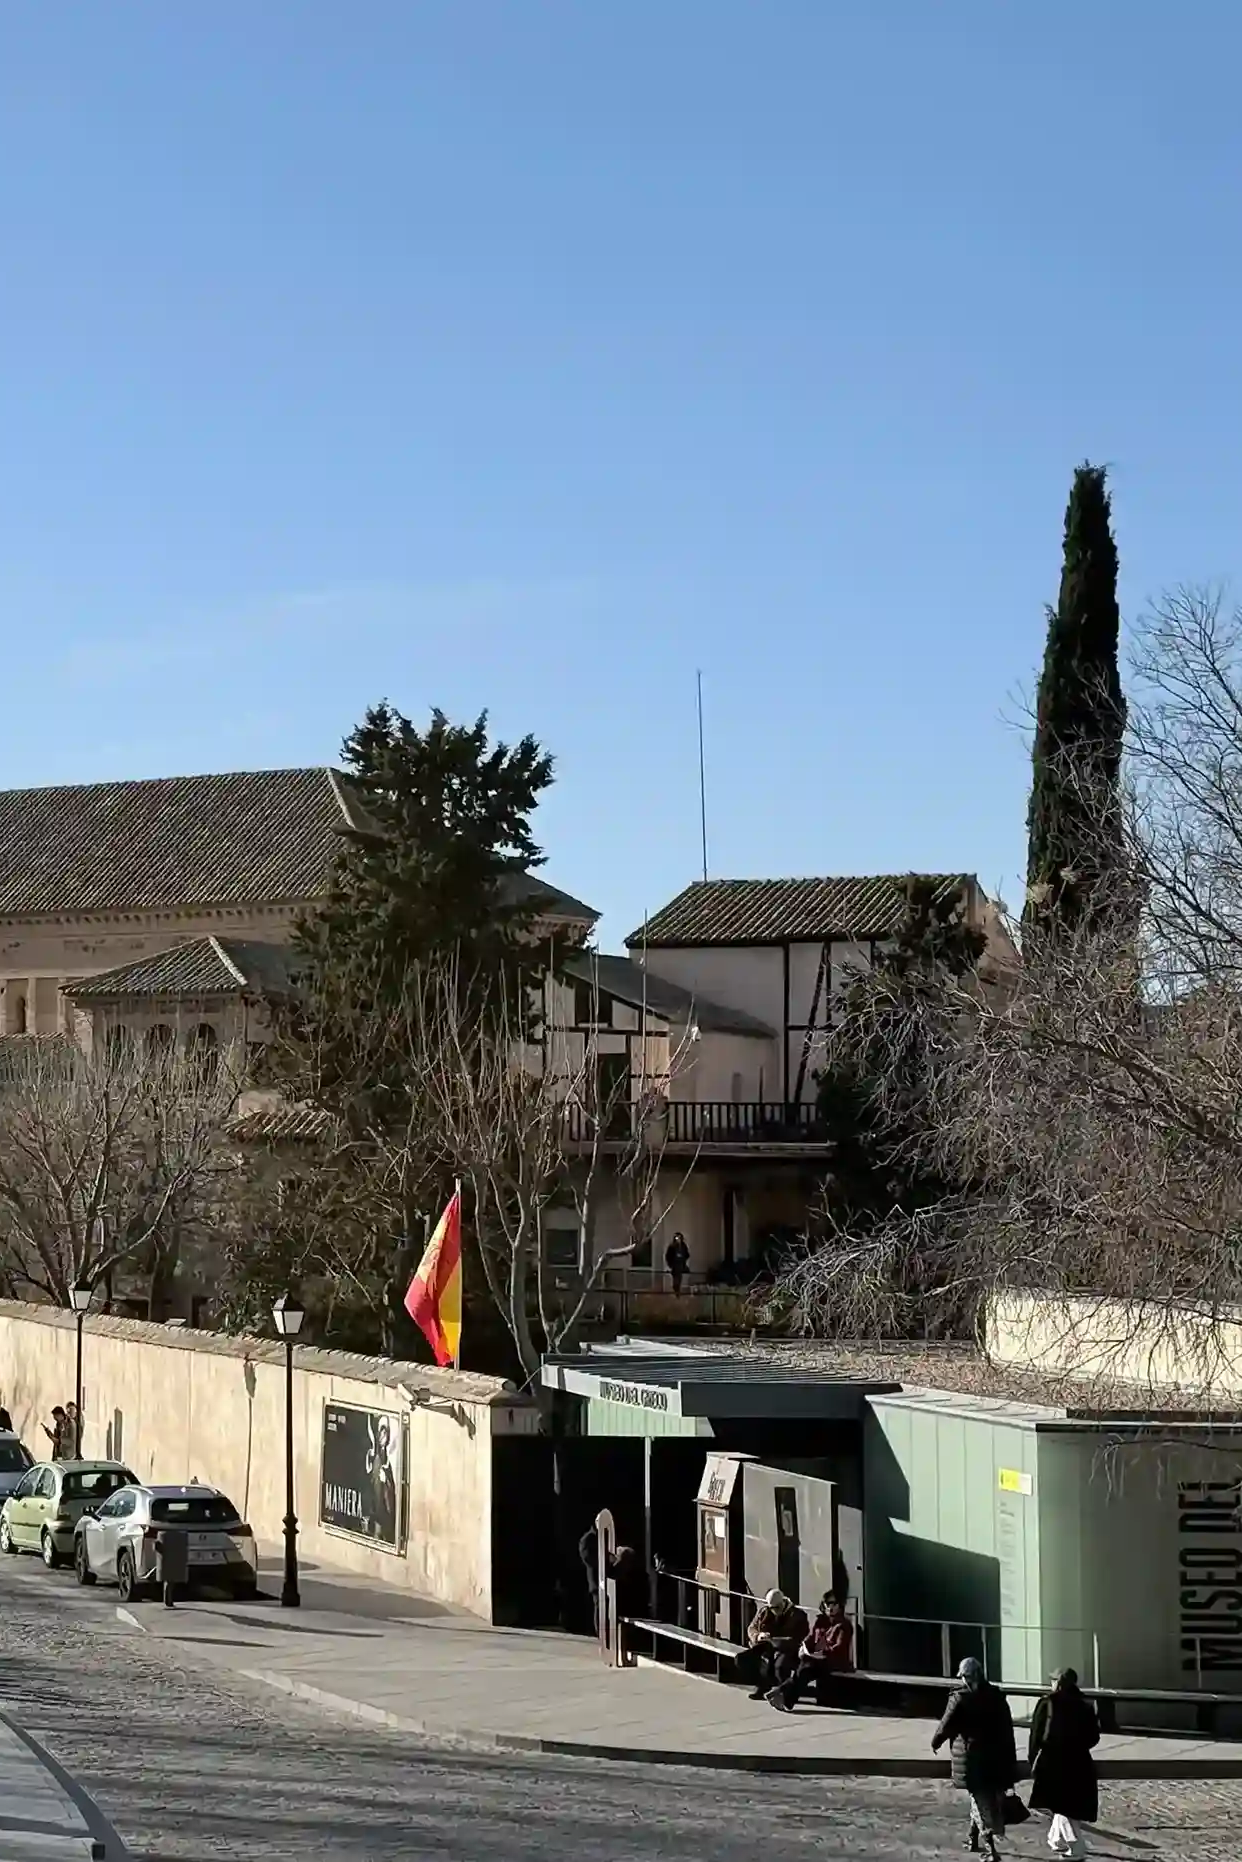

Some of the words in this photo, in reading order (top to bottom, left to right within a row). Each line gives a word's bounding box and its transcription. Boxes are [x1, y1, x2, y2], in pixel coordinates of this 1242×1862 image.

[324, 1482, 363, 1518] MANIERA
[1178, 1478, 1242, 1533] DEL
[1178, 1548, 1242, 1671] MUSEO
